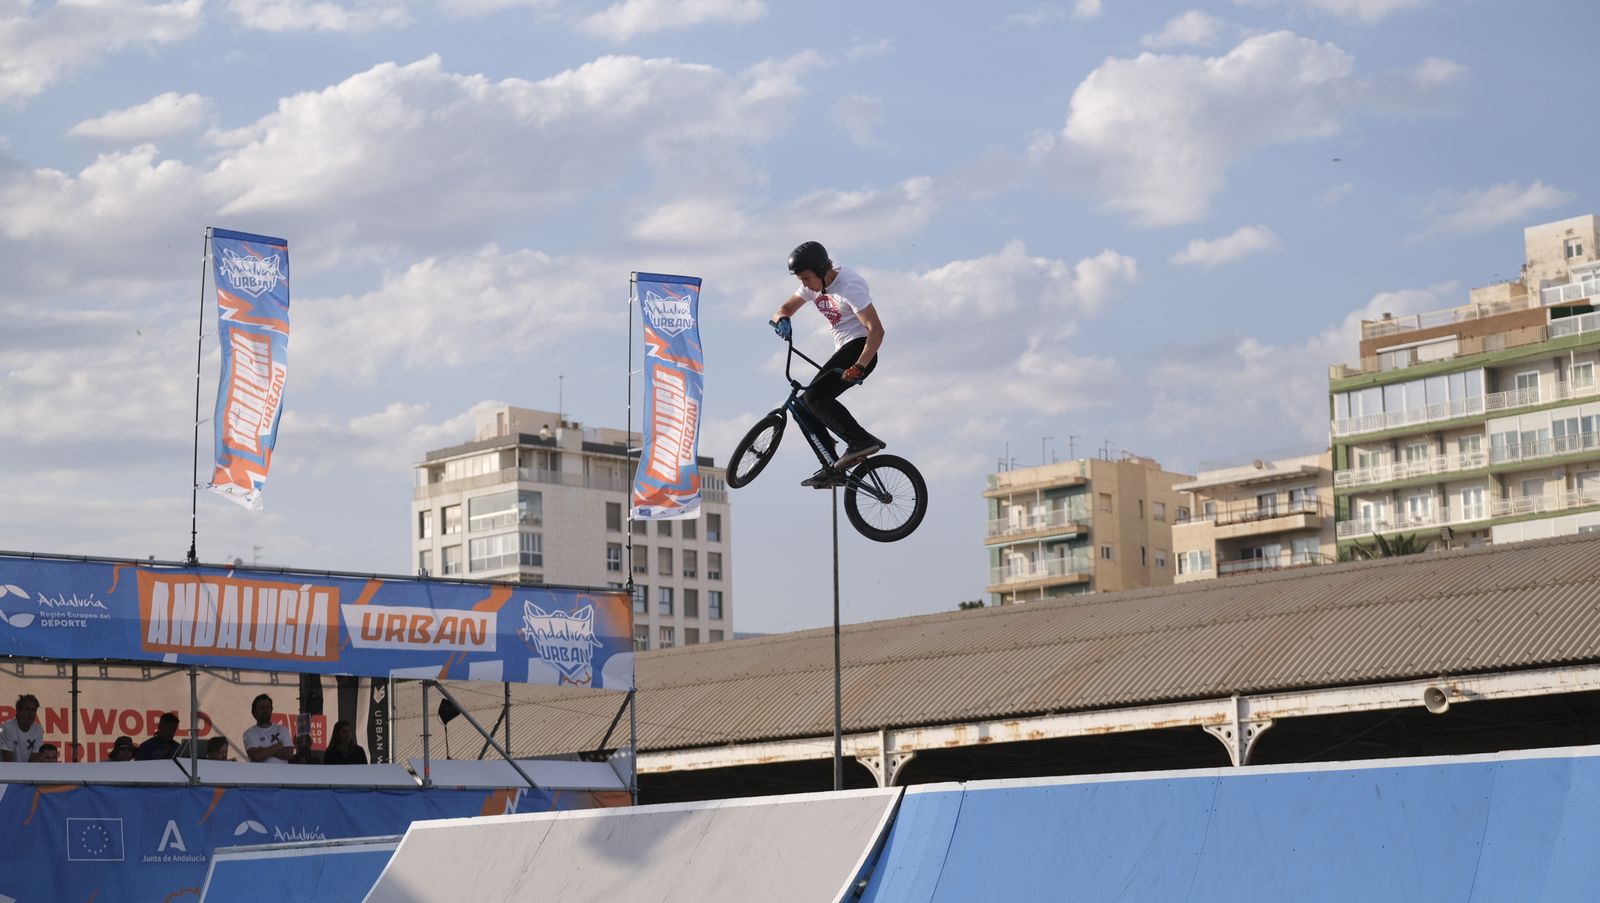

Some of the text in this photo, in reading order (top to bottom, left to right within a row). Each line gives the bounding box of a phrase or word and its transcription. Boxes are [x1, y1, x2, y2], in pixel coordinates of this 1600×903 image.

[653, 317, 691, 328] URBAN
[262, 366, 286, 430] URBAN
[681, 402, 698, 461] URBAN
[37, 592, 108, 610] Andalucía
[39, 611, 111, 620] Región Europea del
[41, 619, 87, 628] DEPORTE
[147, 580, 488, 657] ANDALUCÍA URBAN
[540, 645, 590, 664] URBAN
[374, 710, 384, 750] URBAN
[273, 824, 327, 842] Andalucía
[142, 853, 206, 863] Junta de Andalucía
